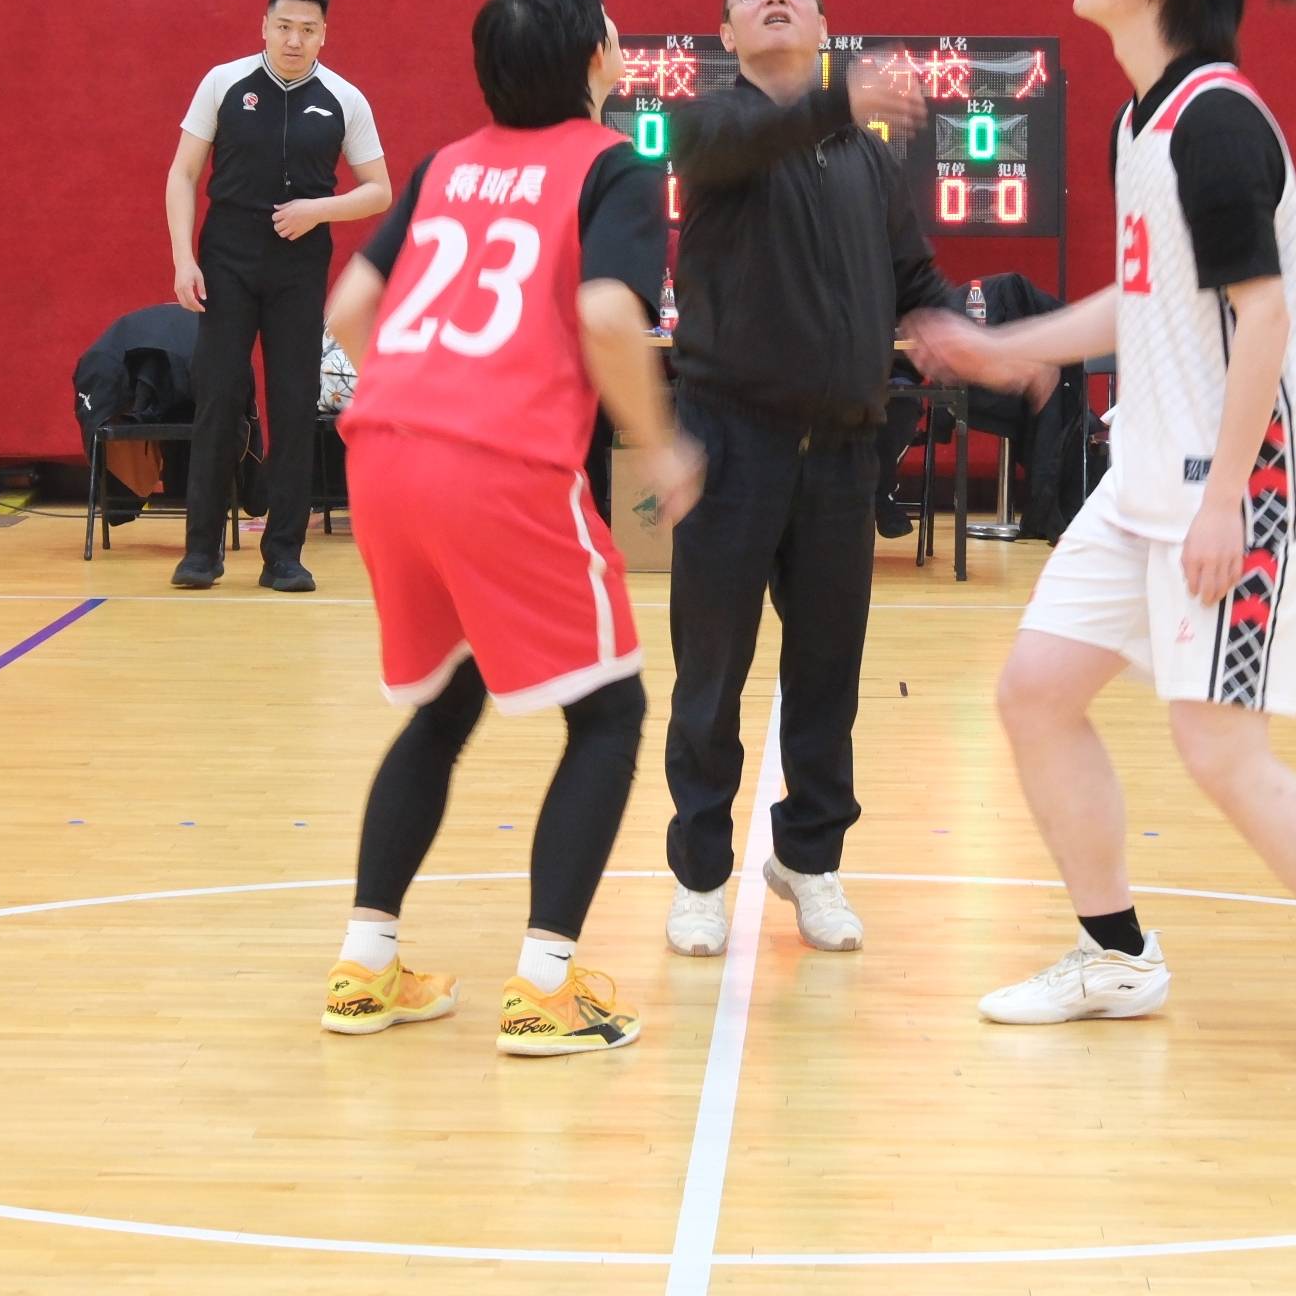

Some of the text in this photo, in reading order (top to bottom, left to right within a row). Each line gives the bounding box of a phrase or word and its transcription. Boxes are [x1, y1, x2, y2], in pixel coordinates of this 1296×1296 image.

[666, 35, 695, 49] 队名
[835, 36, 863, 50] 球权
[940, 37, 968, 51] 队名
[636, 97, 664, 112] 比分
[967, 99, 995, 113] 比分
[636, 111, 665, 157] 0
[968, 114, 996, 159] 0
[937, 163, 1026, 177] 暂停 犯规
[940, 179, 1023, 221] 0 0
[376, 216, 541, 356] 23
